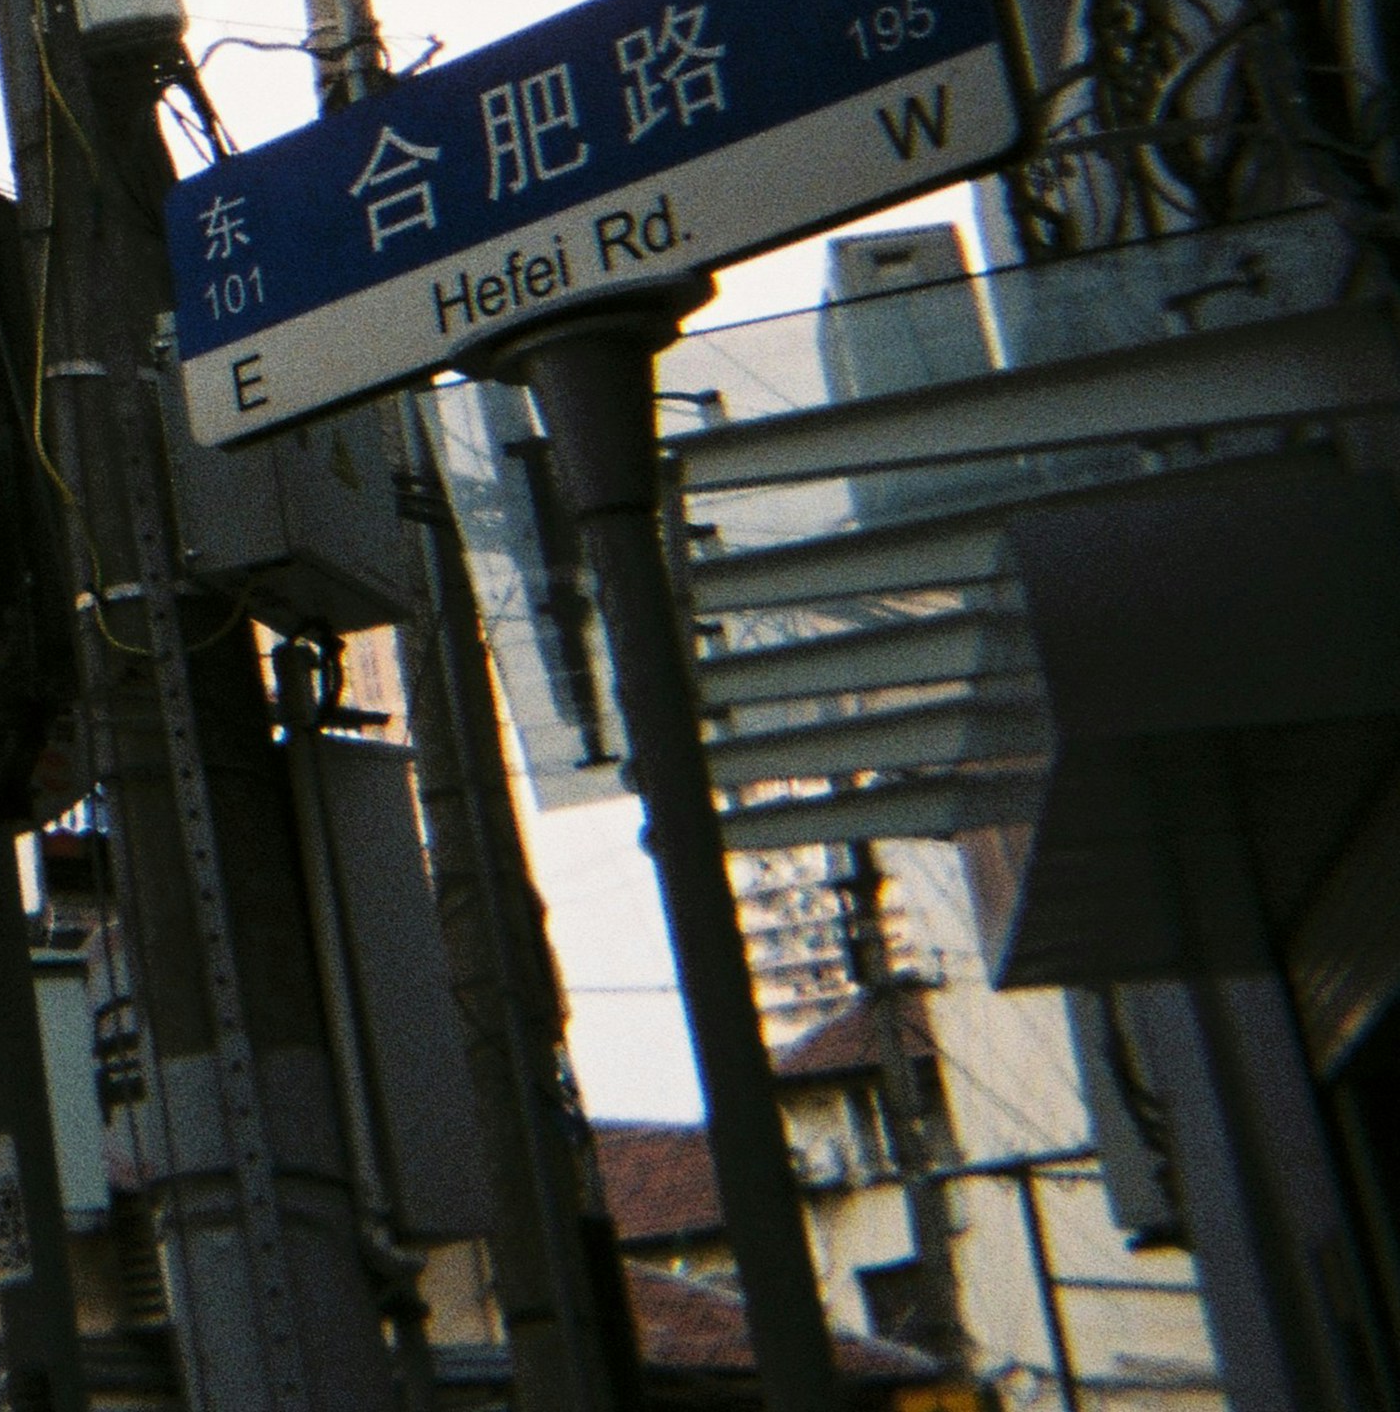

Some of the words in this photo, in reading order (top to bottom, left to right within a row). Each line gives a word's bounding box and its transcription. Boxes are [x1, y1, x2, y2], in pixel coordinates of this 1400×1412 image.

[350, 4, 726, 253] 合肥路
[875, 84, 950, 159] W
[199, 195, 250, 260] 东
[204, 266, 264, 320] 101
[433, 234, 571, 333] Hefei
[594, 194, 693, 271] Rd.
[231, 352, 268, 412] E
